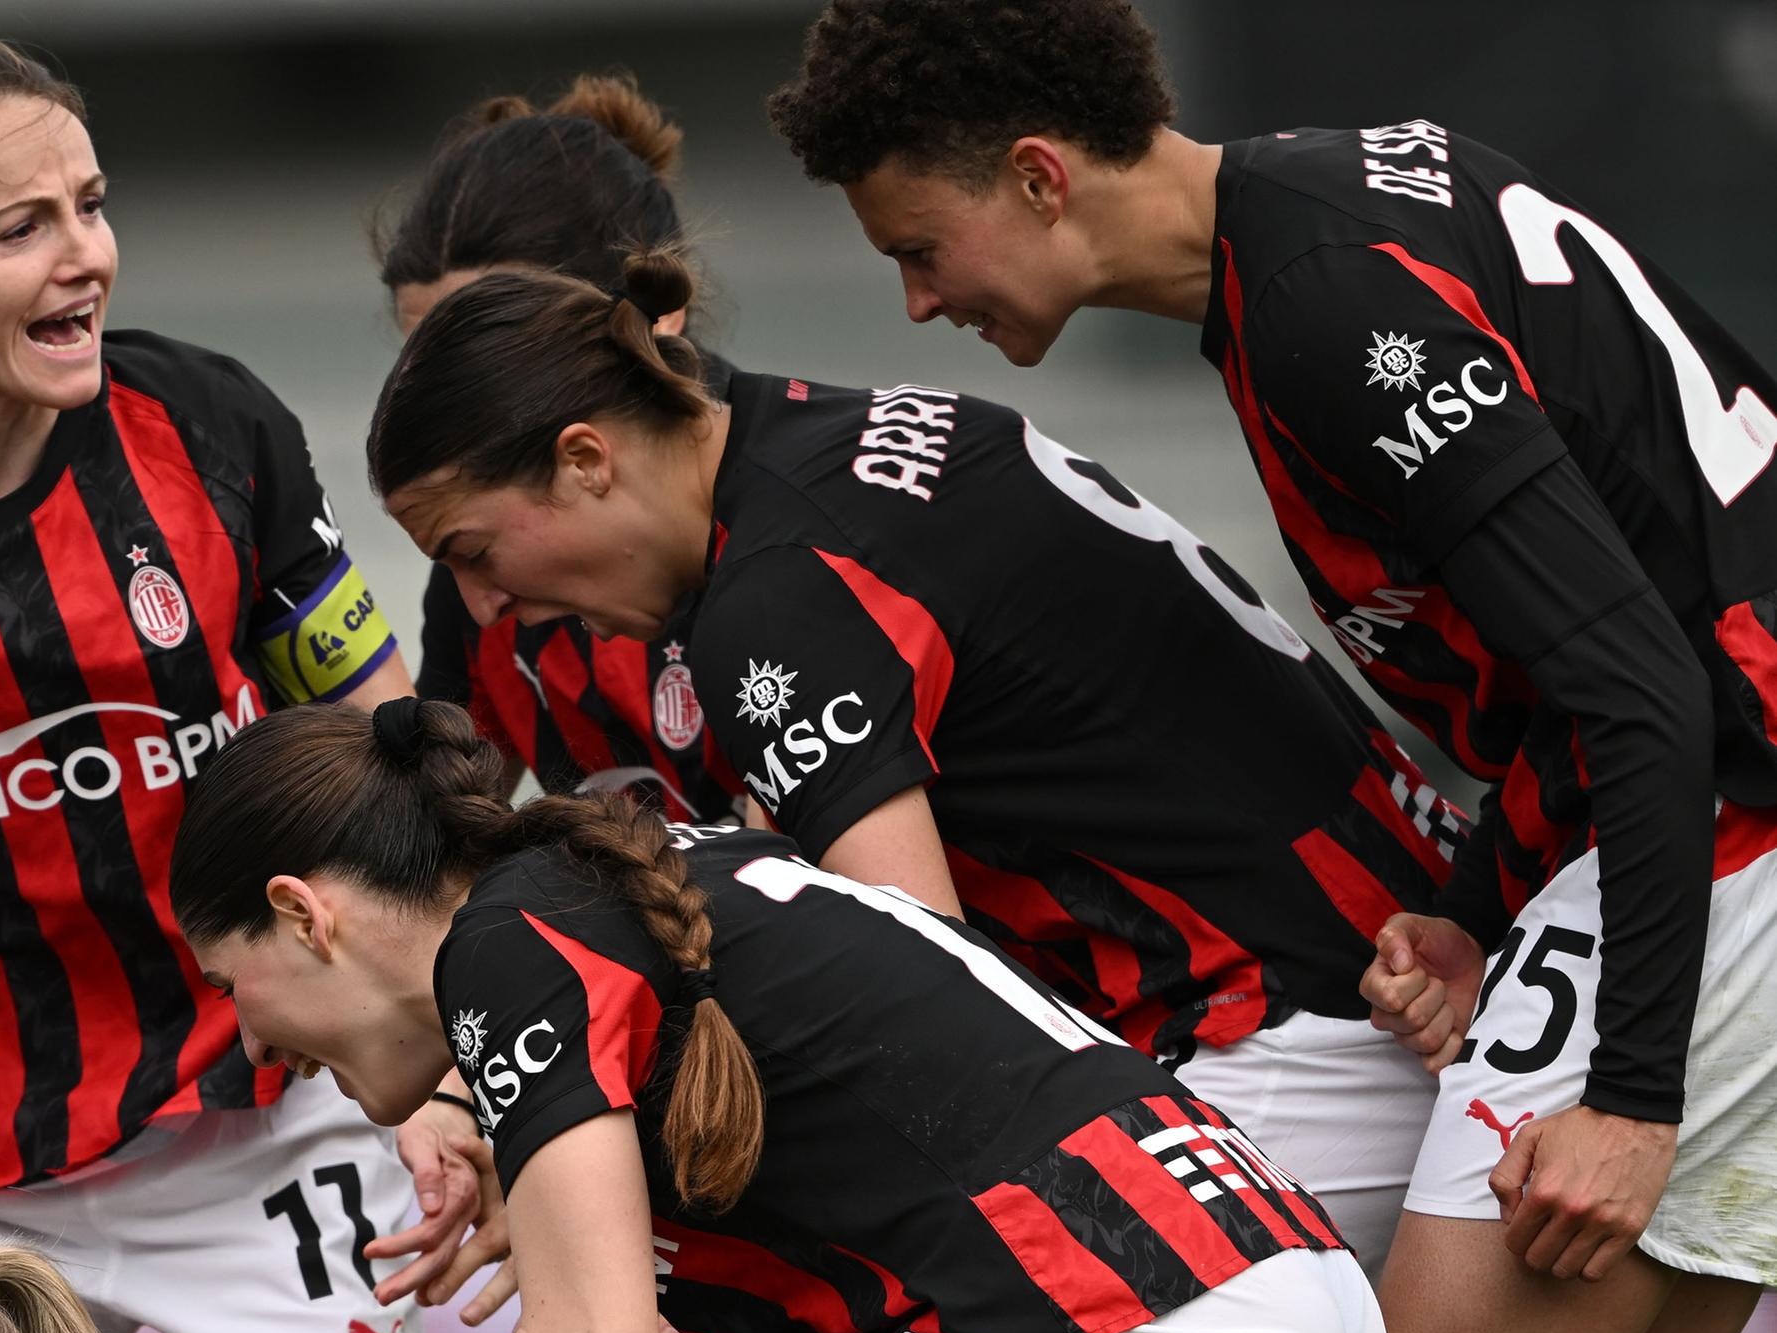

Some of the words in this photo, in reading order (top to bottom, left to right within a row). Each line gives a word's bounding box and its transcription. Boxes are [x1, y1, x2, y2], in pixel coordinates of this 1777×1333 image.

[1359, 119, 1449, 163] SA
[1365, 158, 1453, 209] DE
[850, 383, 960, 502] ARRI
[1372, 356, 1508, 480] MSC
[743, 691, 873, 817] MSC
